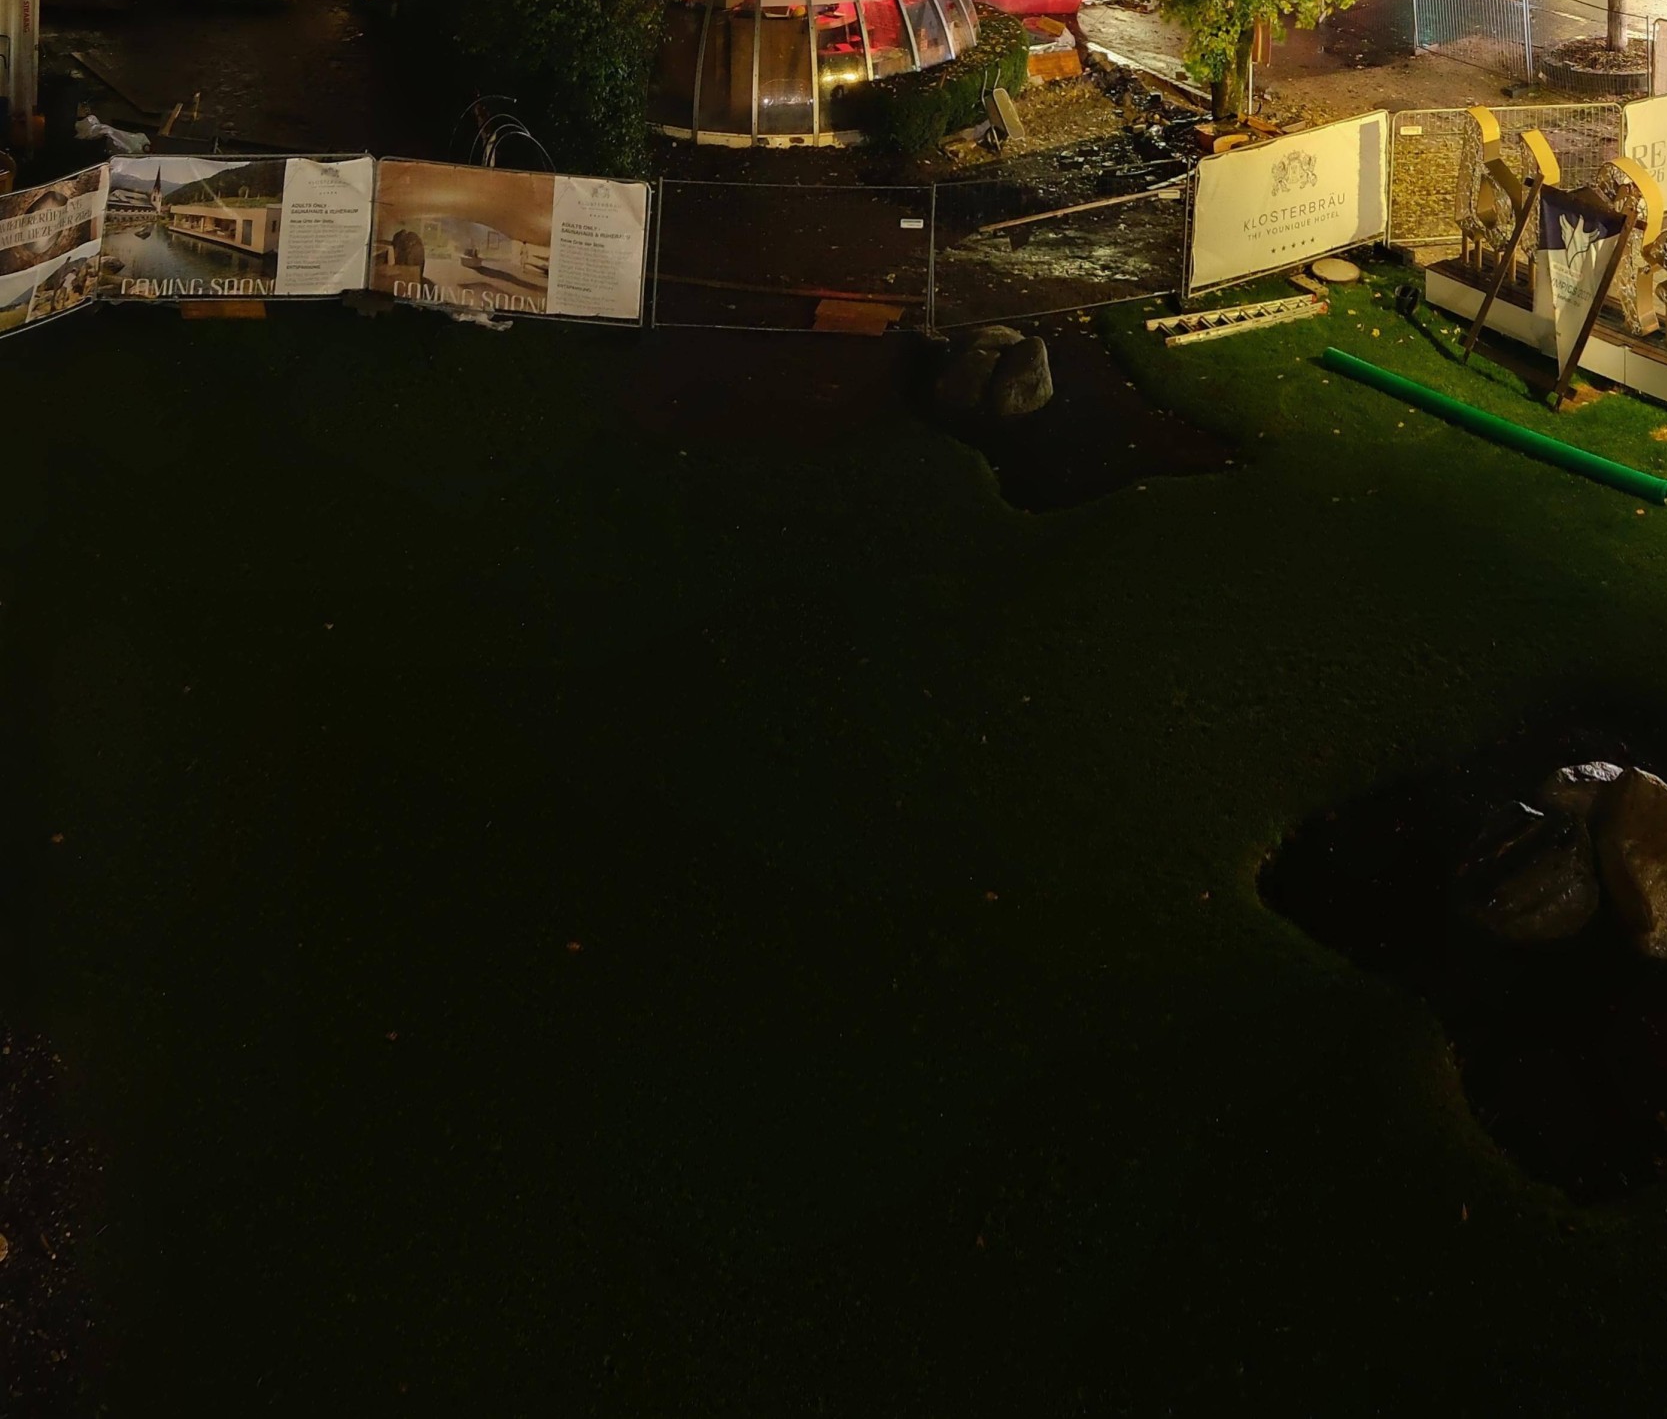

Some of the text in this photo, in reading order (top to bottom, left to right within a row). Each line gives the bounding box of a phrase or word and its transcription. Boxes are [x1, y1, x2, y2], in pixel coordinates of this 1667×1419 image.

[1243, 192, 1346, 232] KLOSTERBRÄU
[1266, 218, 1311, 236] YOUNIQUE
[1314, 211, 1340, 224] HOTEL
[121, 279, 205, 296] COMING
[393, 280, 475, 309] COMING
